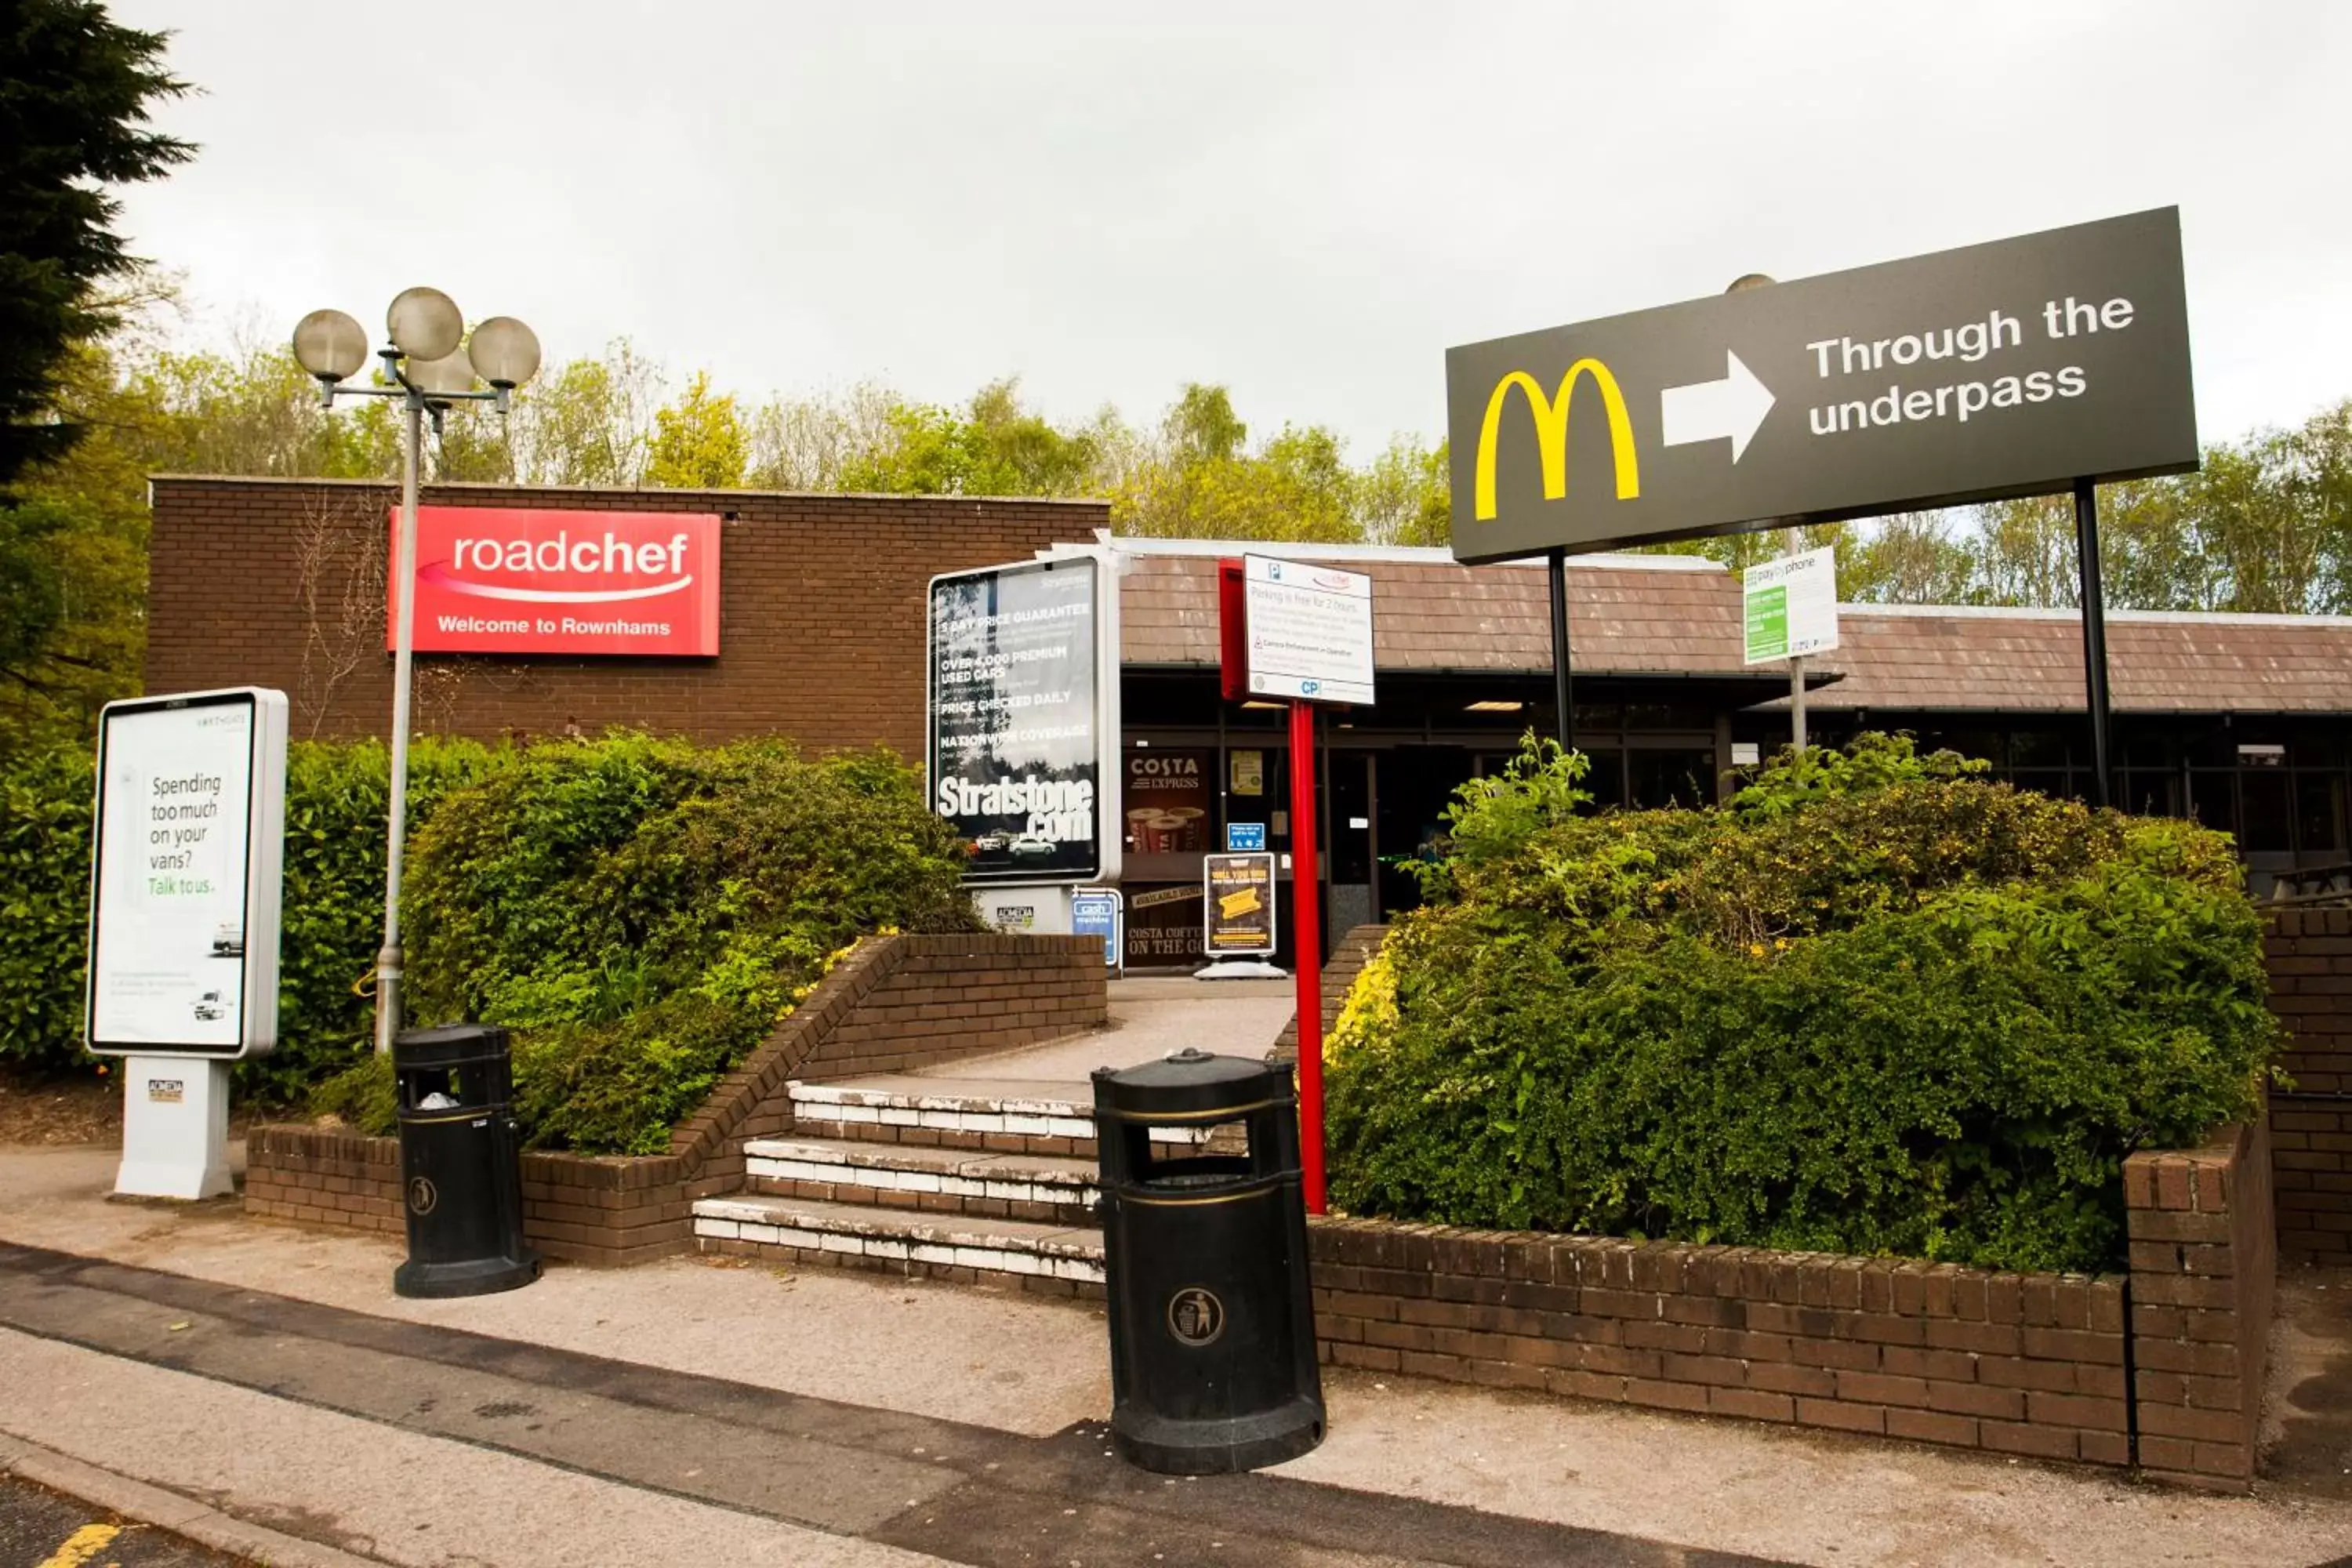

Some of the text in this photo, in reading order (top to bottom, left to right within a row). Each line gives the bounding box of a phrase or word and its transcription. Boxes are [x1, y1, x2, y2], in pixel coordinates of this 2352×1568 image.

[1806, 296, 2134, 378] Through the
[1809, 365, 2087, 434] underpass
[454, 530, 688, 575] roadchef
[1785, 557, 1815, 575] phone
[1250, 586, 1283, 604] Parking
[437, 615, 671, 636] Welcome to Rownhams
[977, 613, 1011, 628] PRICE
[1013, 603, 1091, 623] GUARANTEE
[941, 646, 1067, 671] OVER 4,000 PREMIUM
[941, 667, 1006, 684] USED CARS
[941, 690, 1071, 715] PRICE CHECKED DAILY
[1021, 724, 1089, 741] COVERAGE
[1131, 758, 1199, 775] COSTA
[152, 771, 221, 799] Spending
[1152, 777, 1199, 789] EXPRESS
[938, 774, 1094, 817] Stratstone
[151, 797, 217, 821] too much
[150, 826, 208, 848] on your
[150, 850, 192, 870] vans?
[148, 877, 176, 895] Talk
[180, 879, 194, 895] to
[1081, 902, 1105, 915] cash
[1128, 927, 1163, 939] COSTA
[1129, 940, 1149, 954] ON
[1152, 939, 1184, 954] THE
